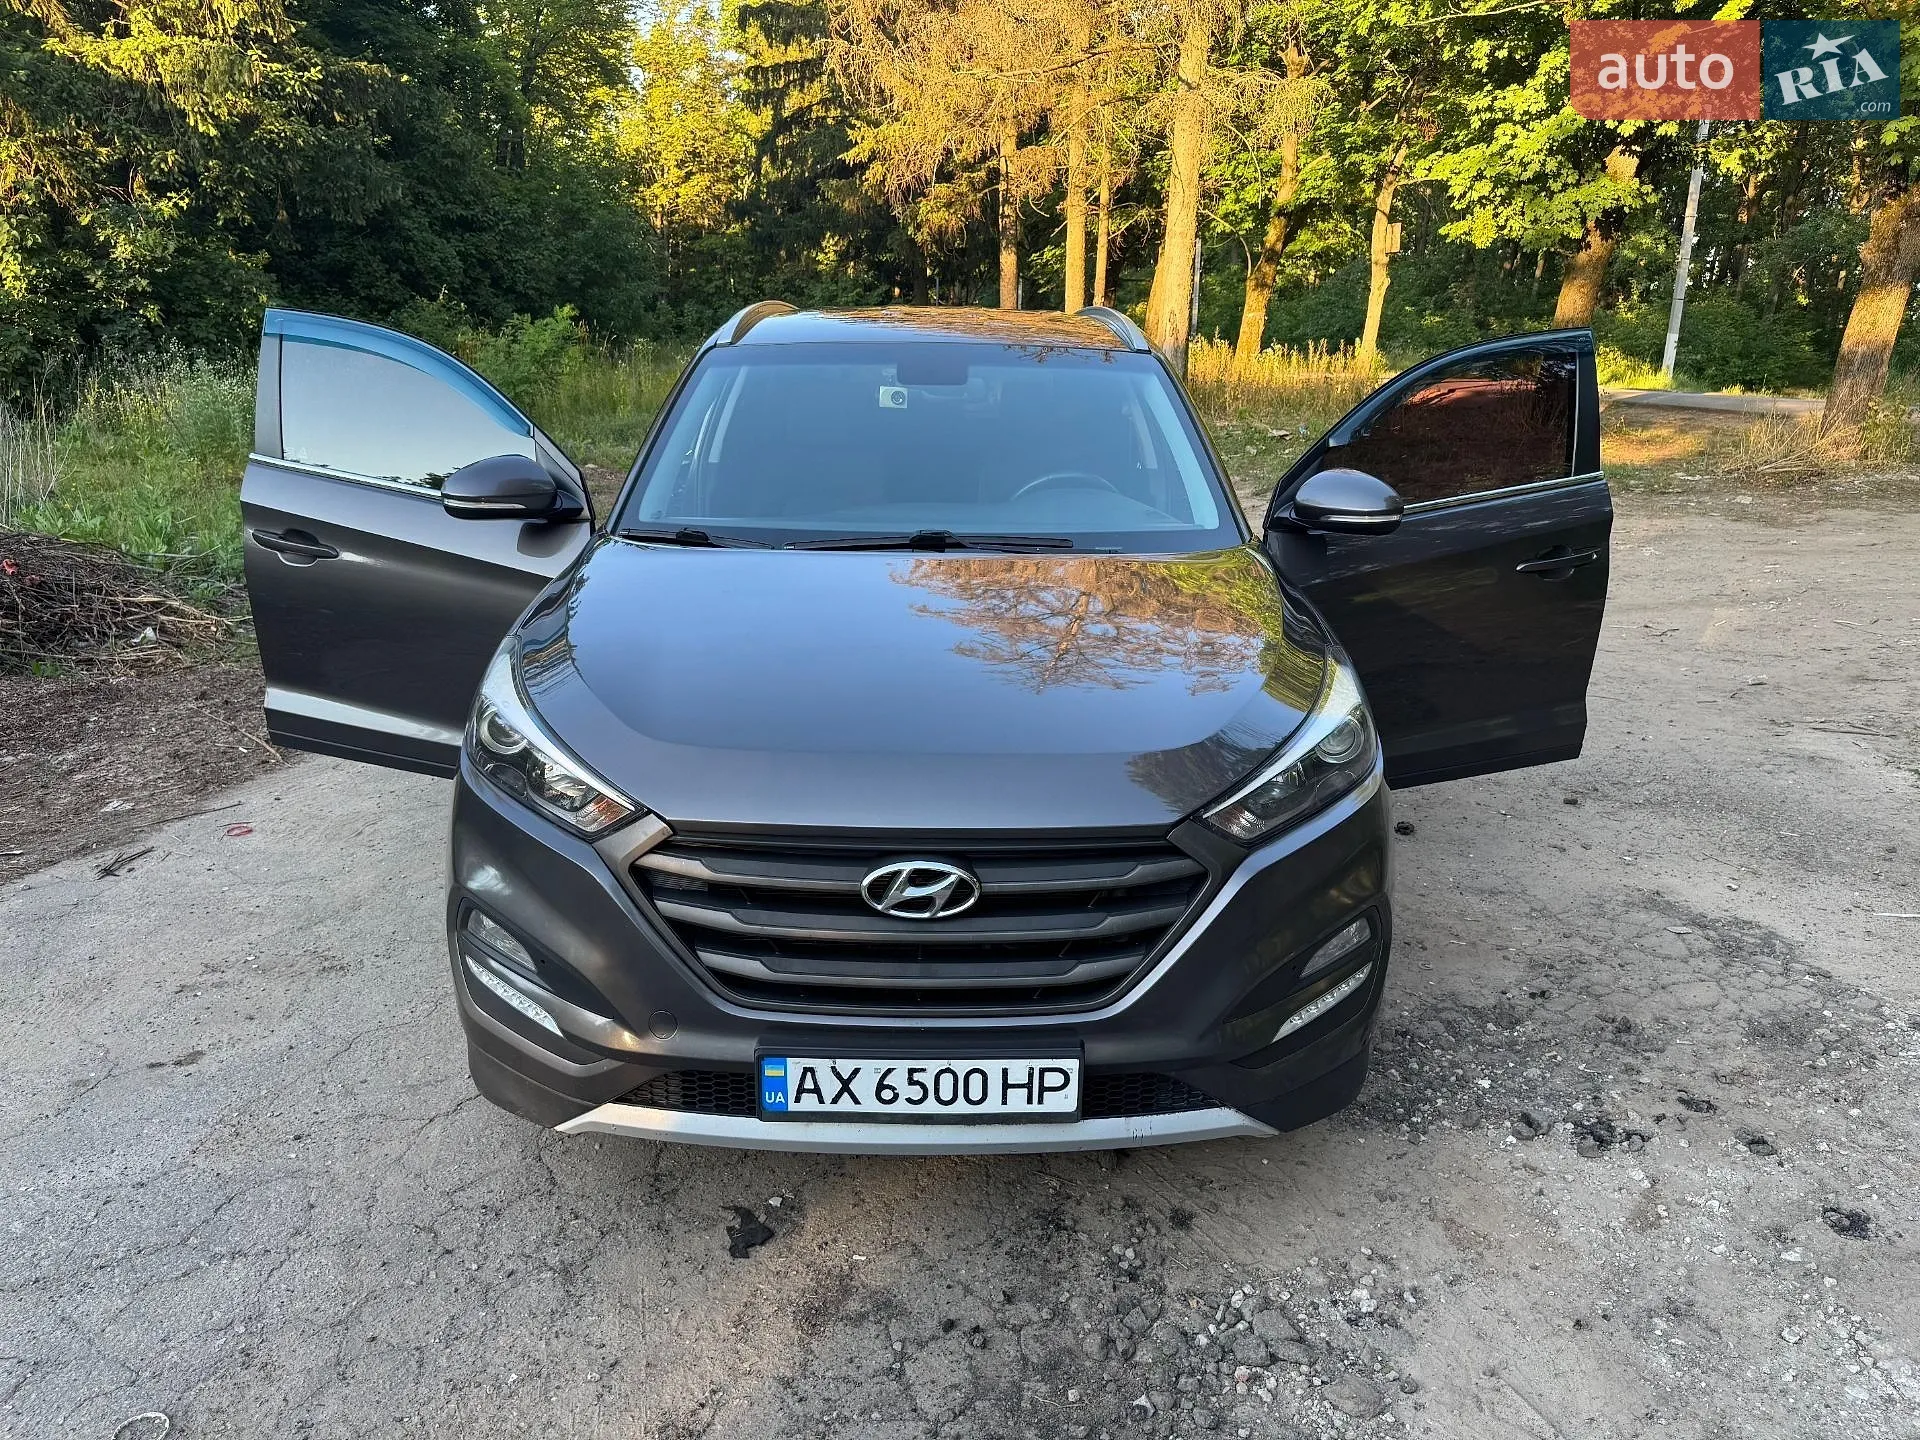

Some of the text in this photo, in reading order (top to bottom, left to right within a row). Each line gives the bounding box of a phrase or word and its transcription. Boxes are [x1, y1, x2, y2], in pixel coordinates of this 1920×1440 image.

[765, 1091, 785, 1104] UA
[793, 1066, 1071, 1107] AX 6500 HP
